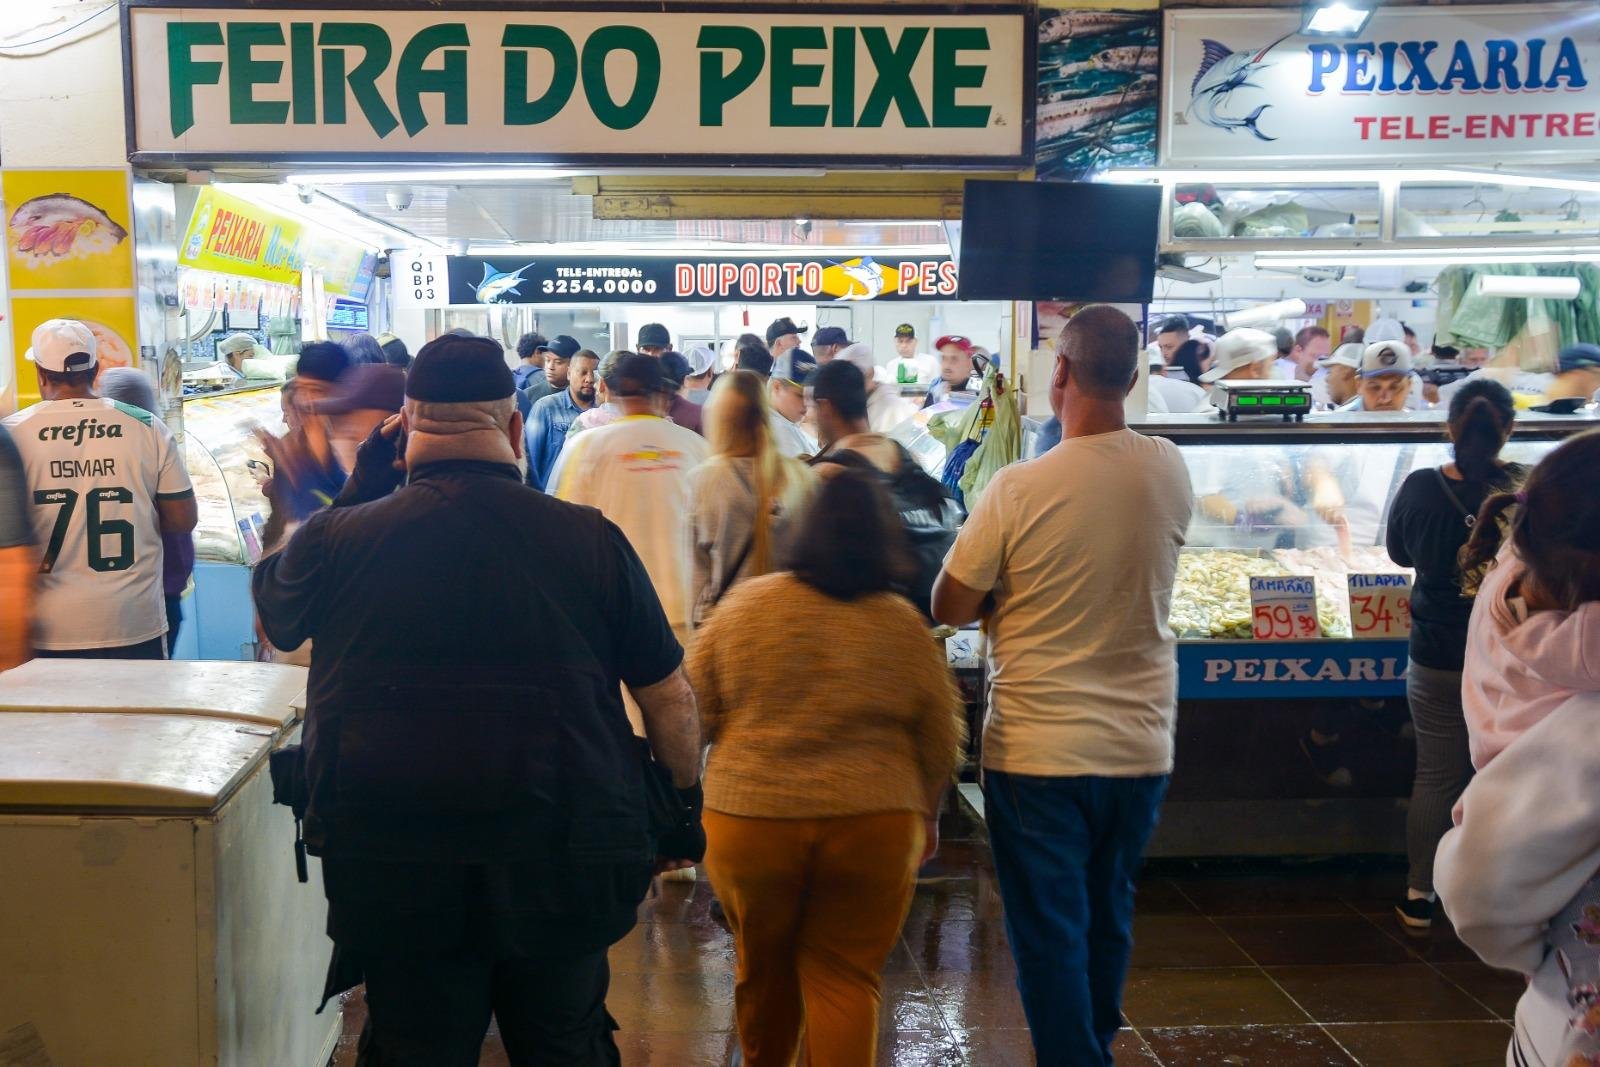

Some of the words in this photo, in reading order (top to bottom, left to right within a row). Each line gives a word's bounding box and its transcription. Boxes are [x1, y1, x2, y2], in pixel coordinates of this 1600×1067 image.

[1306, 37, 1588, 95] PEIXARIA
[167, 22, 471, 139] FEIRA
[501, 24, 660, 130] DO
[696, 25, 992, 128] PEIXE
[1354, 112, 1600, 140] TELE-ENTRE
[205, 208, 266, 262] PEIXARIA
[542, 279, 657, 294] 3254.0000
[556, 267, 643, 278] TELE-ENTREGA:
[675, 262, 824, 296] DUPORTO
[38, 418, 123, 446] crefisa
[50, 458, 115, 478] OSMAR
[33, 486, 136, 574] 76
[1250, 577, 1313, 593] CAMARÃO
[1349, 574, 1407, 588] TILAPIA
